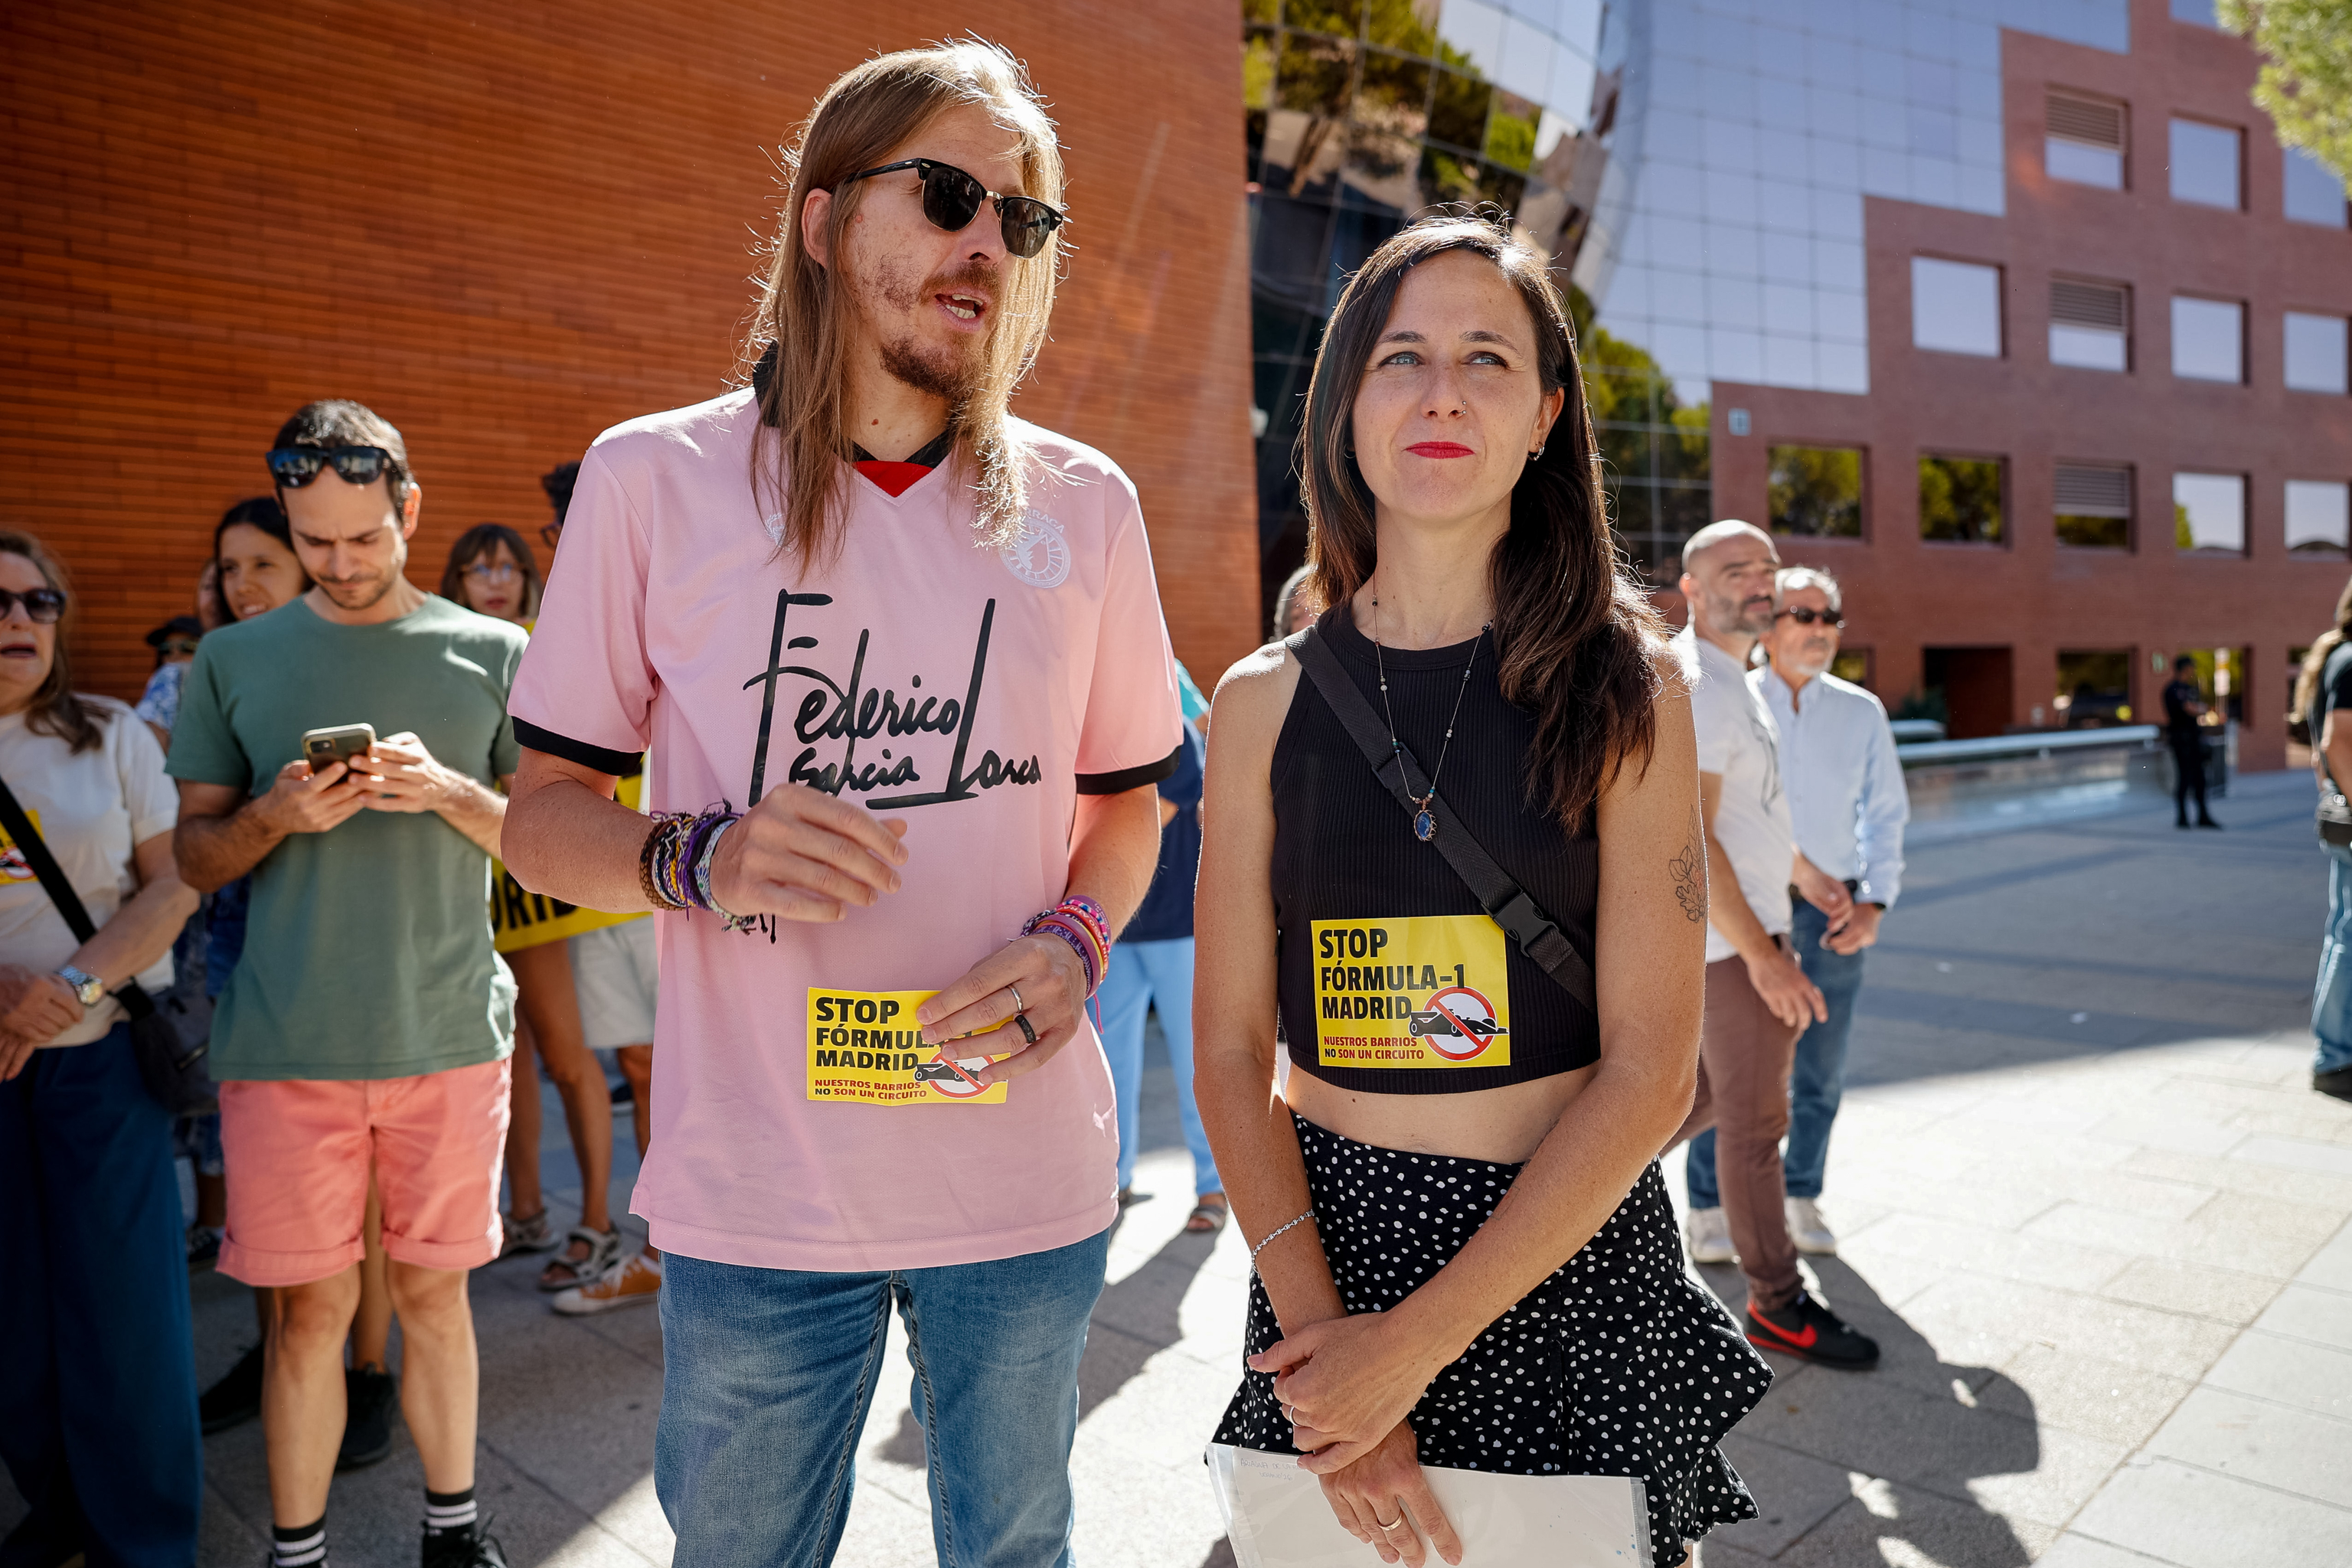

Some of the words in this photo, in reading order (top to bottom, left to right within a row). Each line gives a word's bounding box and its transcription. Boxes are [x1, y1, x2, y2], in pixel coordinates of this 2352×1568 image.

[743, 589, 960, 808] Federico
[1319, 928, 1388, 959] STOP
[1321, 961, 1464, 991] FÓRMULA-1
[815, 997, 900, 1024] STOP
[1322, 996, 1412, 1020] MADRID
[1324, 1036, 1367, 1047] NUESTROS
[1370, 1037, 1417, 1047] BARRIOS
[816, 1050, 919, 1071] MADRID
[1325, 1049, 1336, 1058] NO
[1338, 1050, 1355, 1059] SON
[1358, 1050, 1371, 1059] UN
[1375, 1049, 1424, 1060] CIRCUITO
[815, 1079, 871, 1089] NUESTROS
[874, 1082, 921, 1091] BARRIOS
[878, 1090, 927, 1100] CIRCUITO
